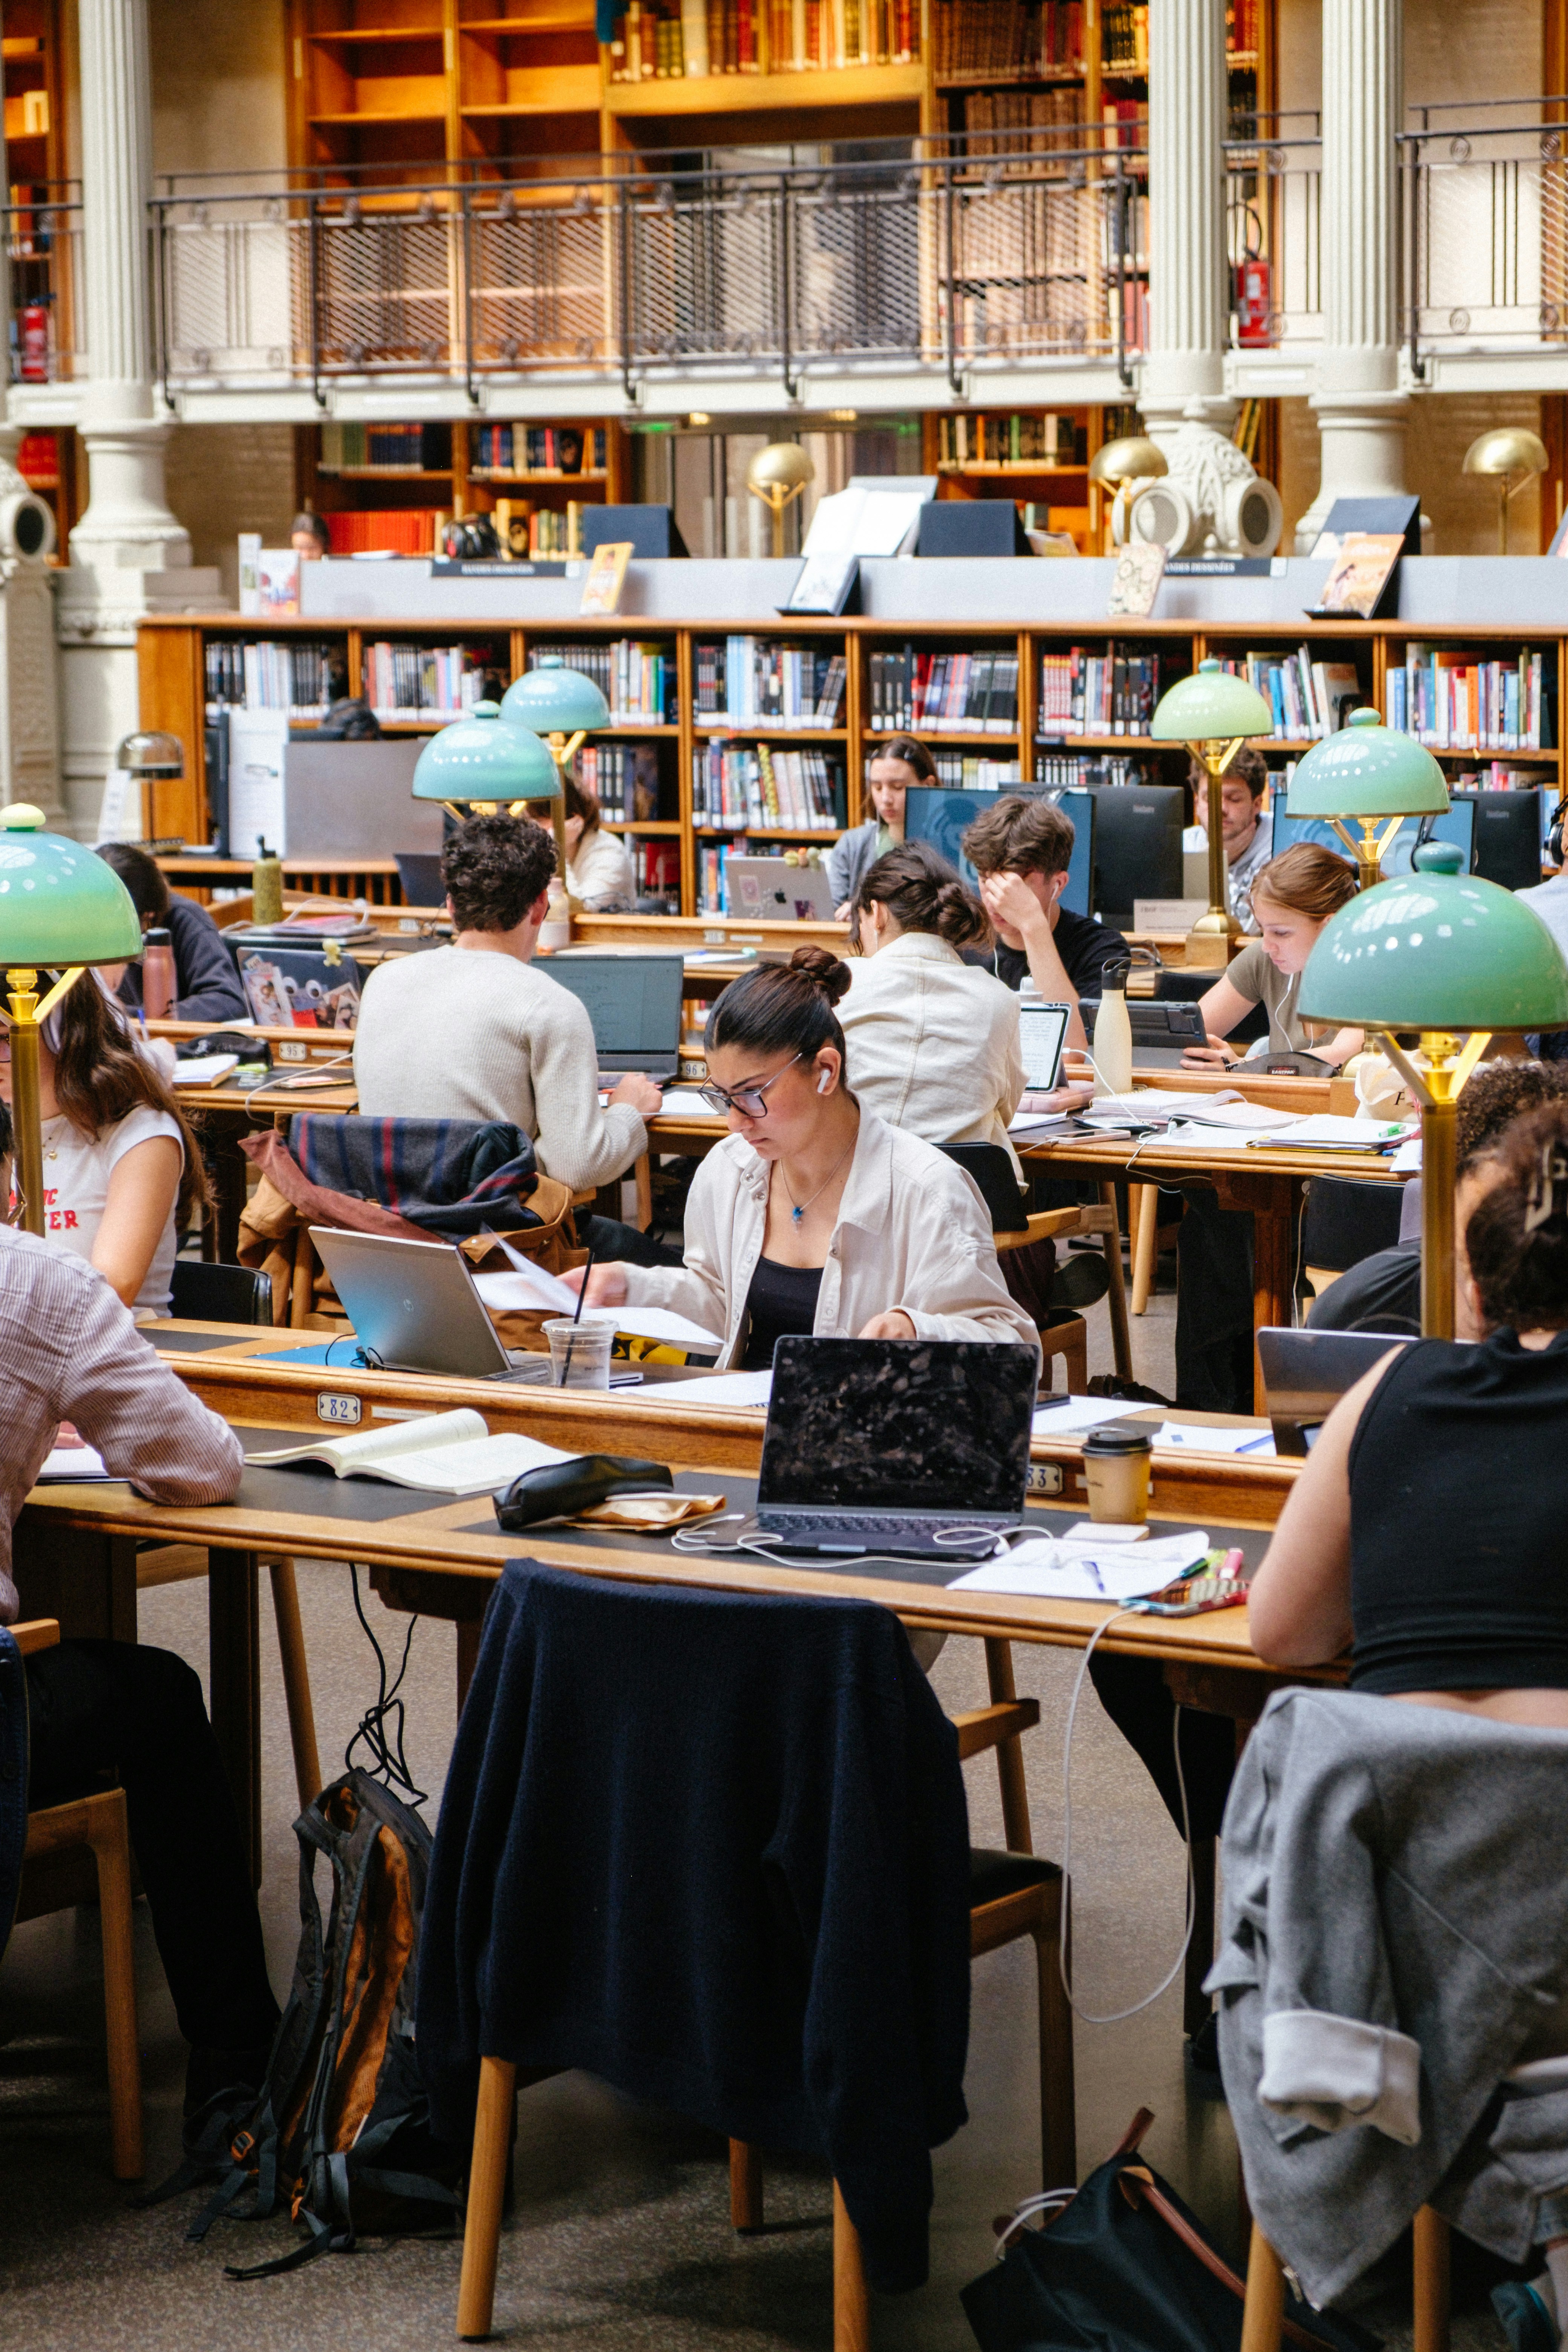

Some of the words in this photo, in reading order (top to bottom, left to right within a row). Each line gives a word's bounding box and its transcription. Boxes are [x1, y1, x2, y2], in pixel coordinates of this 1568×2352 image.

[287, 1046, 297, 1056] 95
[686, 1064, 697, 1075] 96
[330, 1398, 348, 1418] 82
